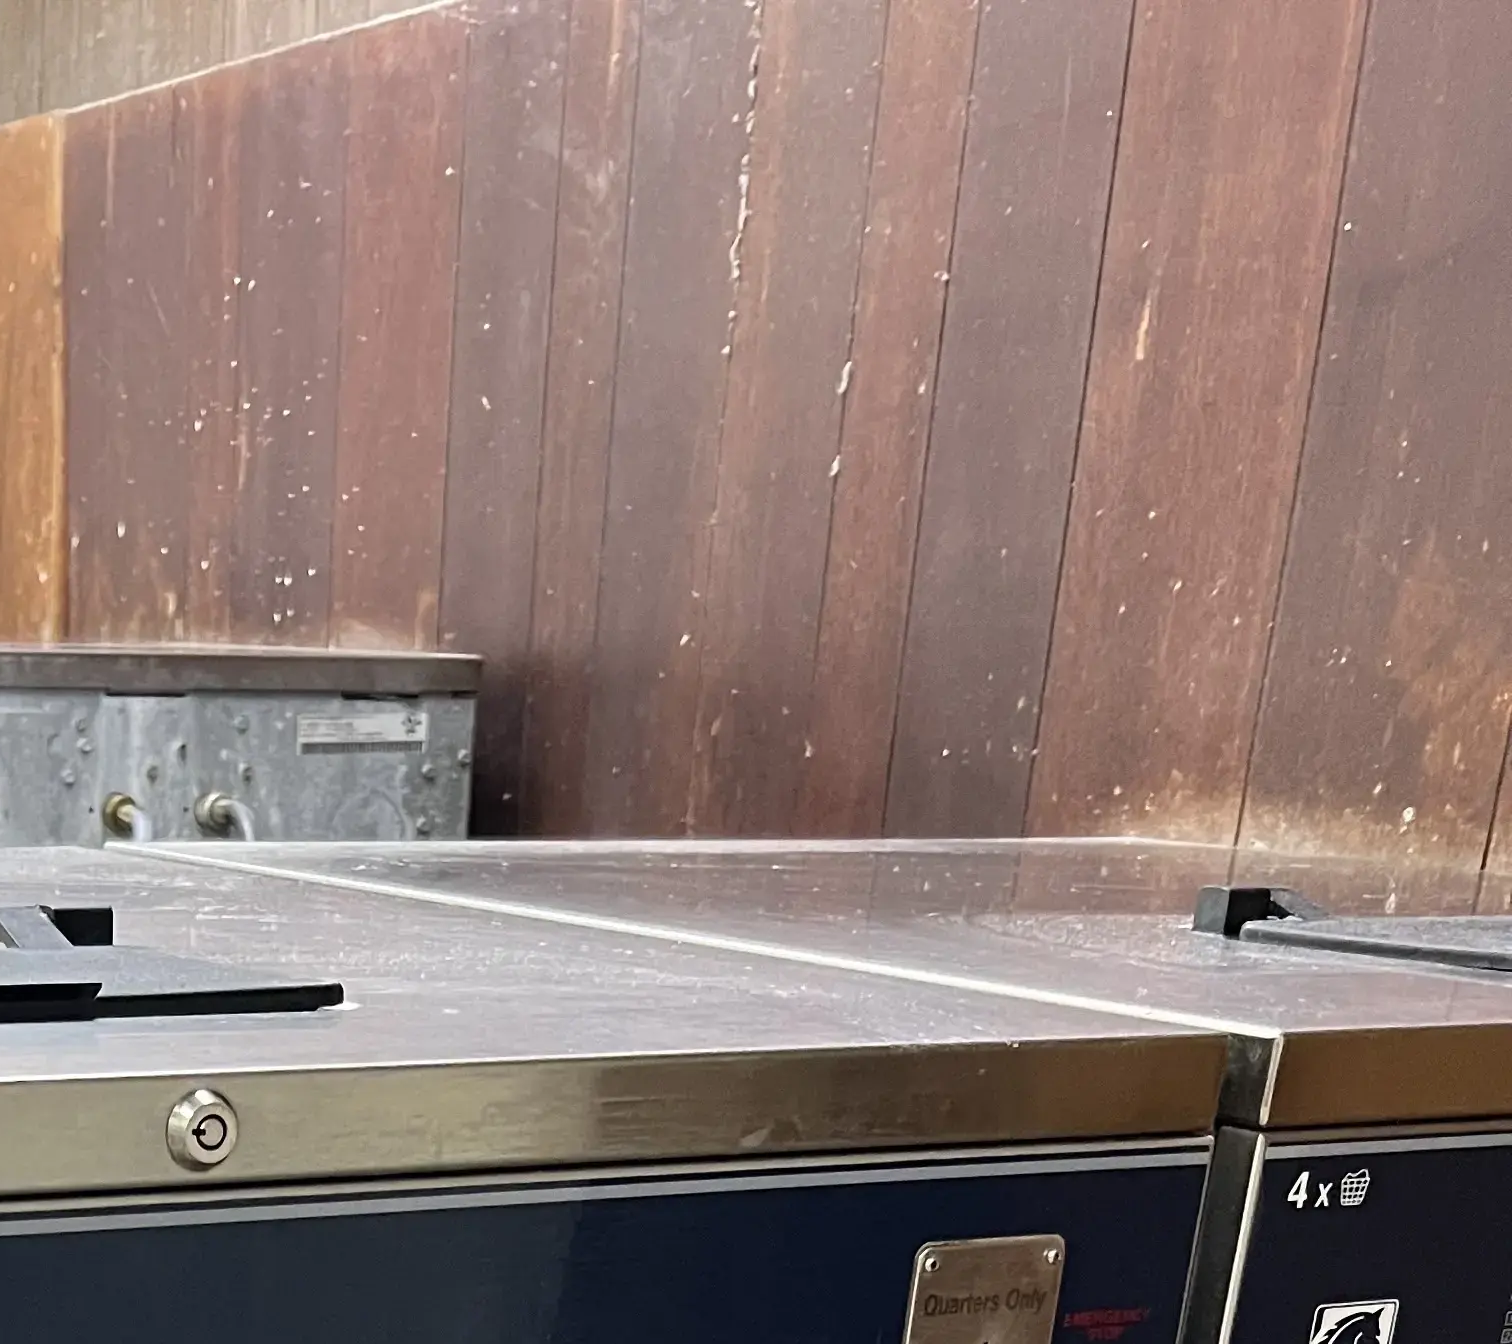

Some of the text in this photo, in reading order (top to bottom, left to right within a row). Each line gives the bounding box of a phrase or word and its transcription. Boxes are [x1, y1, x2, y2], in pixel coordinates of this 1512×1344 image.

[1287, 1171, 1332, 1209] 4 x
[924, 1287, 1047, 1316] Quarters Only
